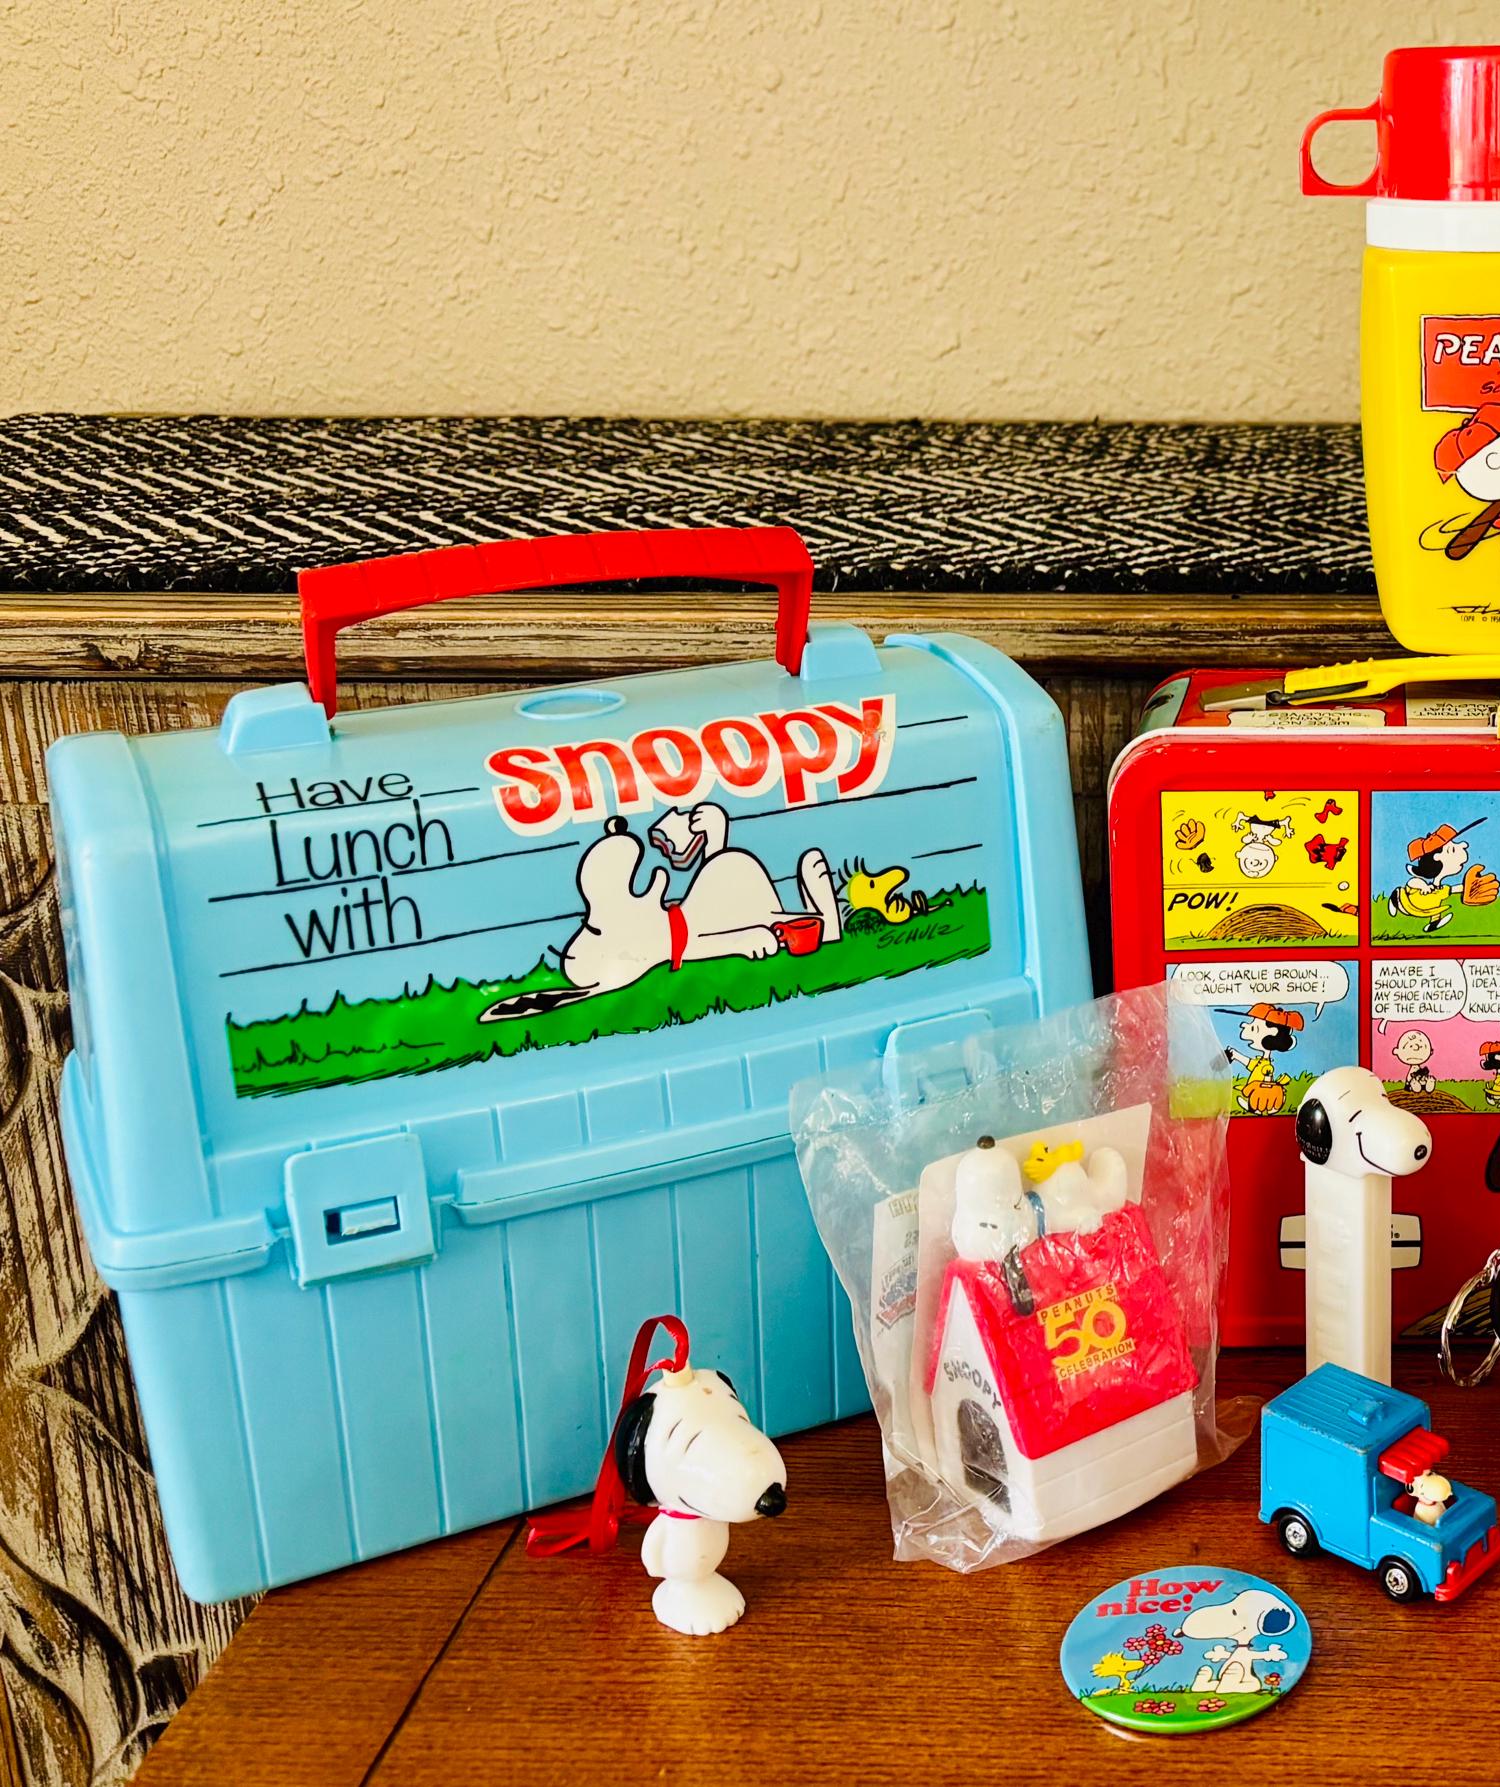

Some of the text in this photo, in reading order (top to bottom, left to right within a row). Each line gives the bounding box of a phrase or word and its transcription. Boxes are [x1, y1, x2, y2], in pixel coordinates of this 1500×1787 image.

[487, 697, 885, 826] snoopy
[256, 773, 413, 813] Have
[270, 799, 454, 887] Lunch
[1167, 891, 1238, 912] POW!
[284, 876, 422, 958] with
[1180, 971, 1216, 983] LOOK,
[1219, 970, 1268, 981] CHARLIE
[1379, 966, 1435, 977] MAYBE I
[1193, 982, 1242, 994] CAUGHT
[1250, 982, 1280, 993] YOUR
[1374, 978, 1452, 989] SHOULD PITCH
[1374, 990, 1464, 1001] MY SHOE INSTEAD
[1375, 1003, 1390, 1013] OF
[1396, 1003, 1415, 1013] THE
[1040, 1284, 1116, 1323] PEANUTS
[1044, 1300, 1127, 1368] 50
[1059, 1341, 1134, 1378] CELEBRATION
[943, 1360, 1002, 1409] SNOOPY
[1128, 1578, 1225, 1598] How
[1096, 1594, 1193, 1617] nice!
